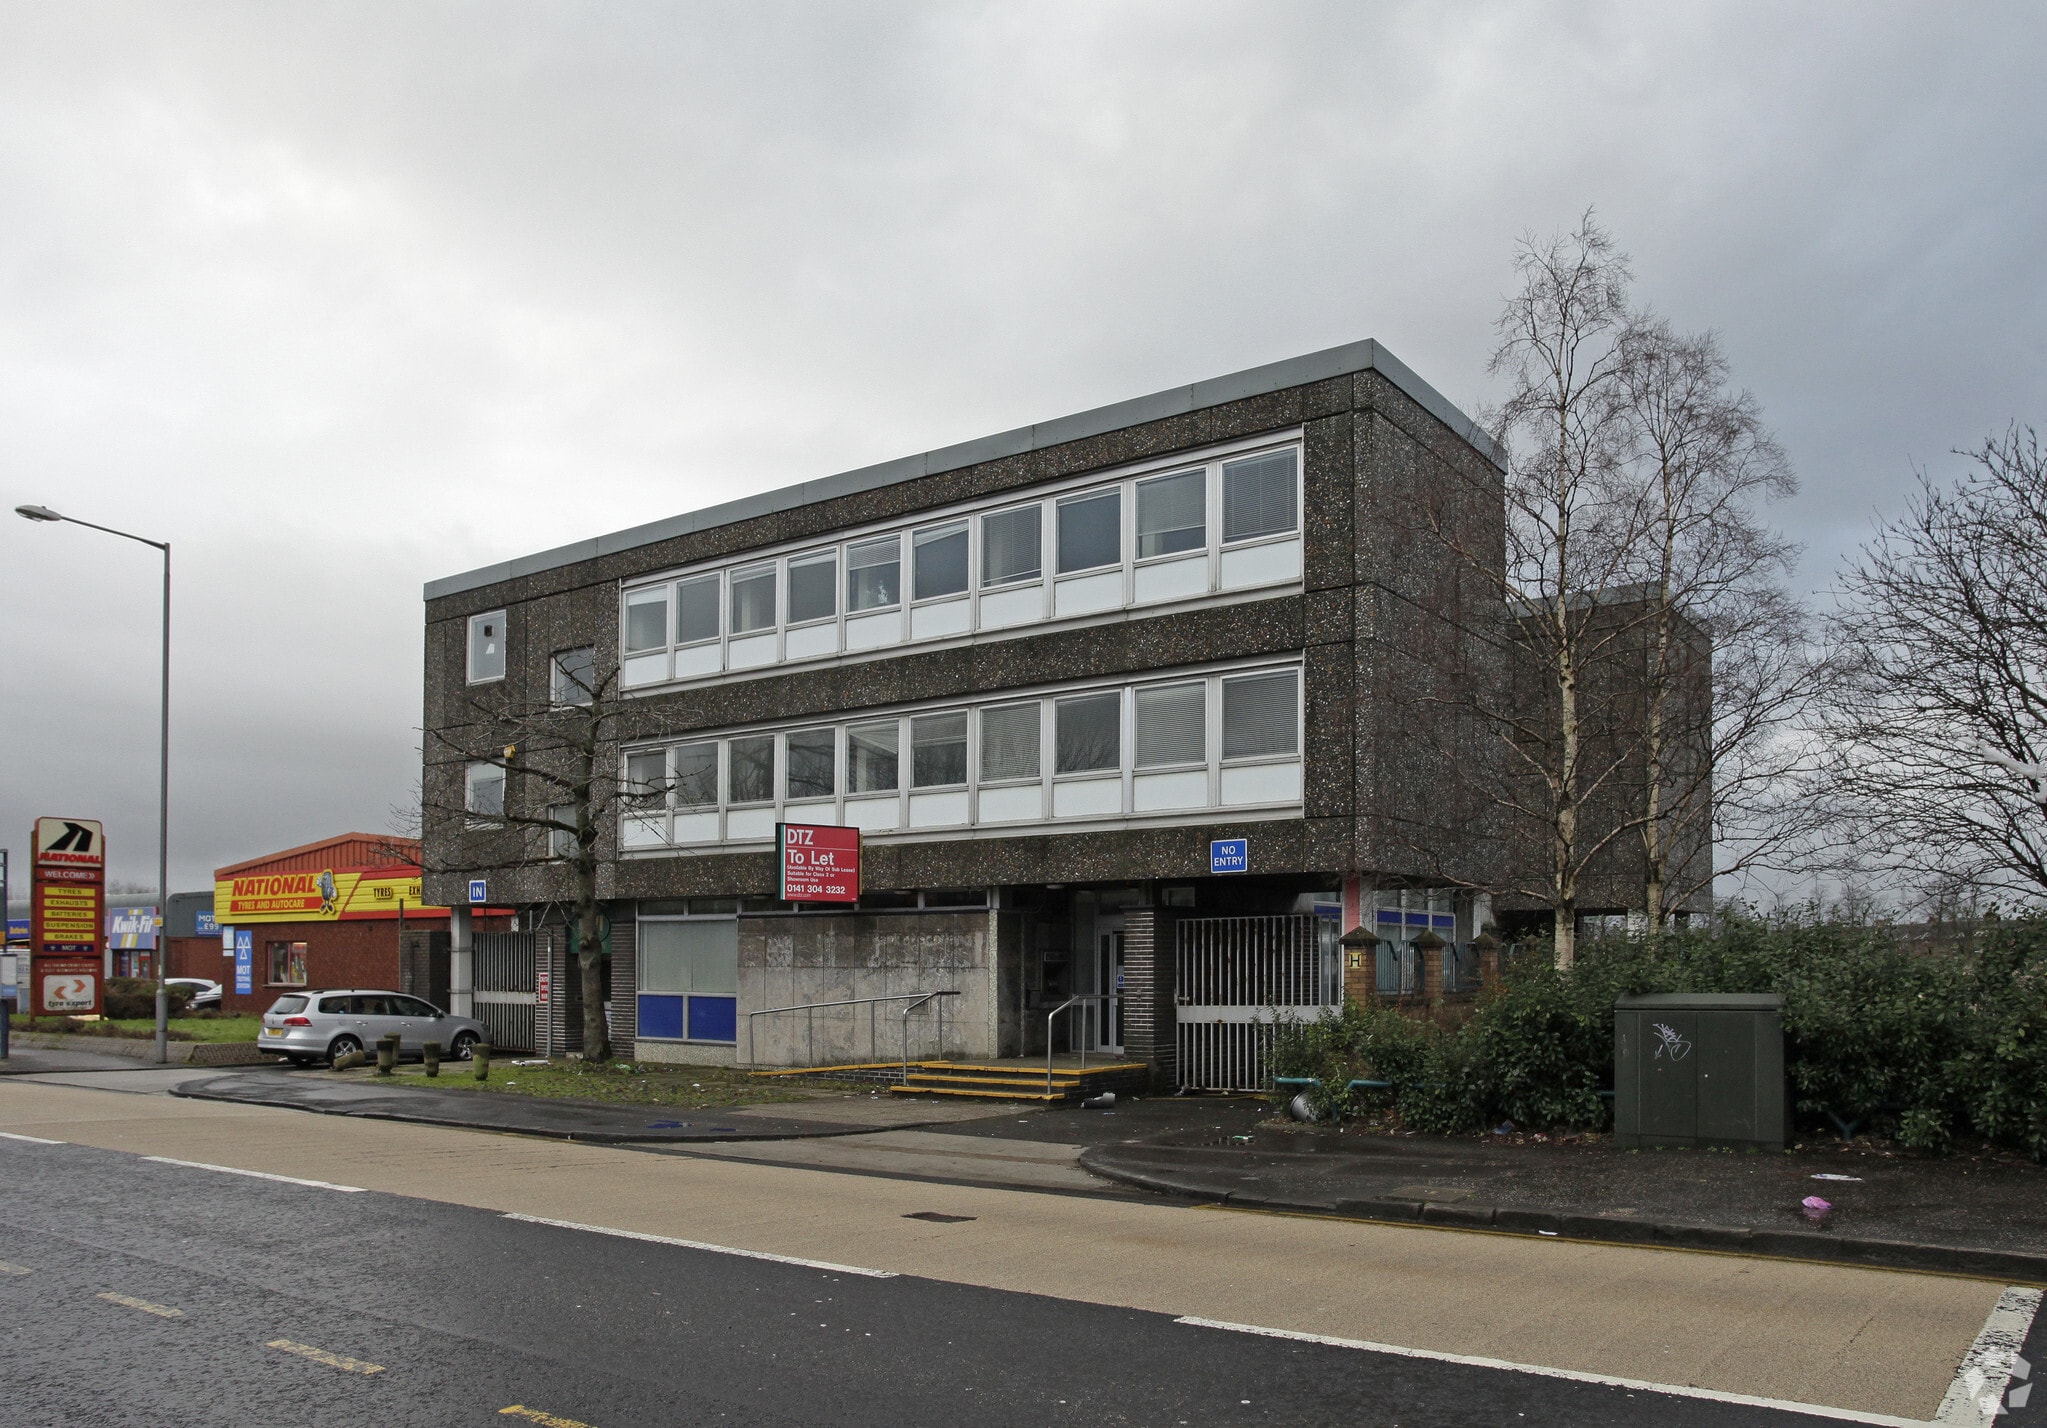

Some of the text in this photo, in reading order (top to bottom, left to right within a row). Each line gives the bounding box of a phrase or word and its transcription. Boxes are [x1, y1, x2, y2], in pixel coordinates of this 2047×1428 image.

[787, 829, 813, 845] DTZ
[1222, 846, 1235, 855] NO
[40, 852, 101, 864] NATIONAL
[787, 850, 834, 865] To Let
[1214, 857, 1243, 866] ENTRY
[44, 871, 89, 879] WELCOME
[232, 874, 316, 896] NATIONAL
[807, 885, 822, 893] 304
[826, 886, 845, 894] 3232
[373, 887, 392, 898] TYRES
[473, 886, 483, 896] IN
[238, 899, 305, 910] TYRES AND AUTOCARE
[112, 915, 154, 934] Kwik-Fit
[1350, 954, 1360, 967] H
[236, 965, 251, 975] MOT
[66, 1000, 92, 1008] expert
